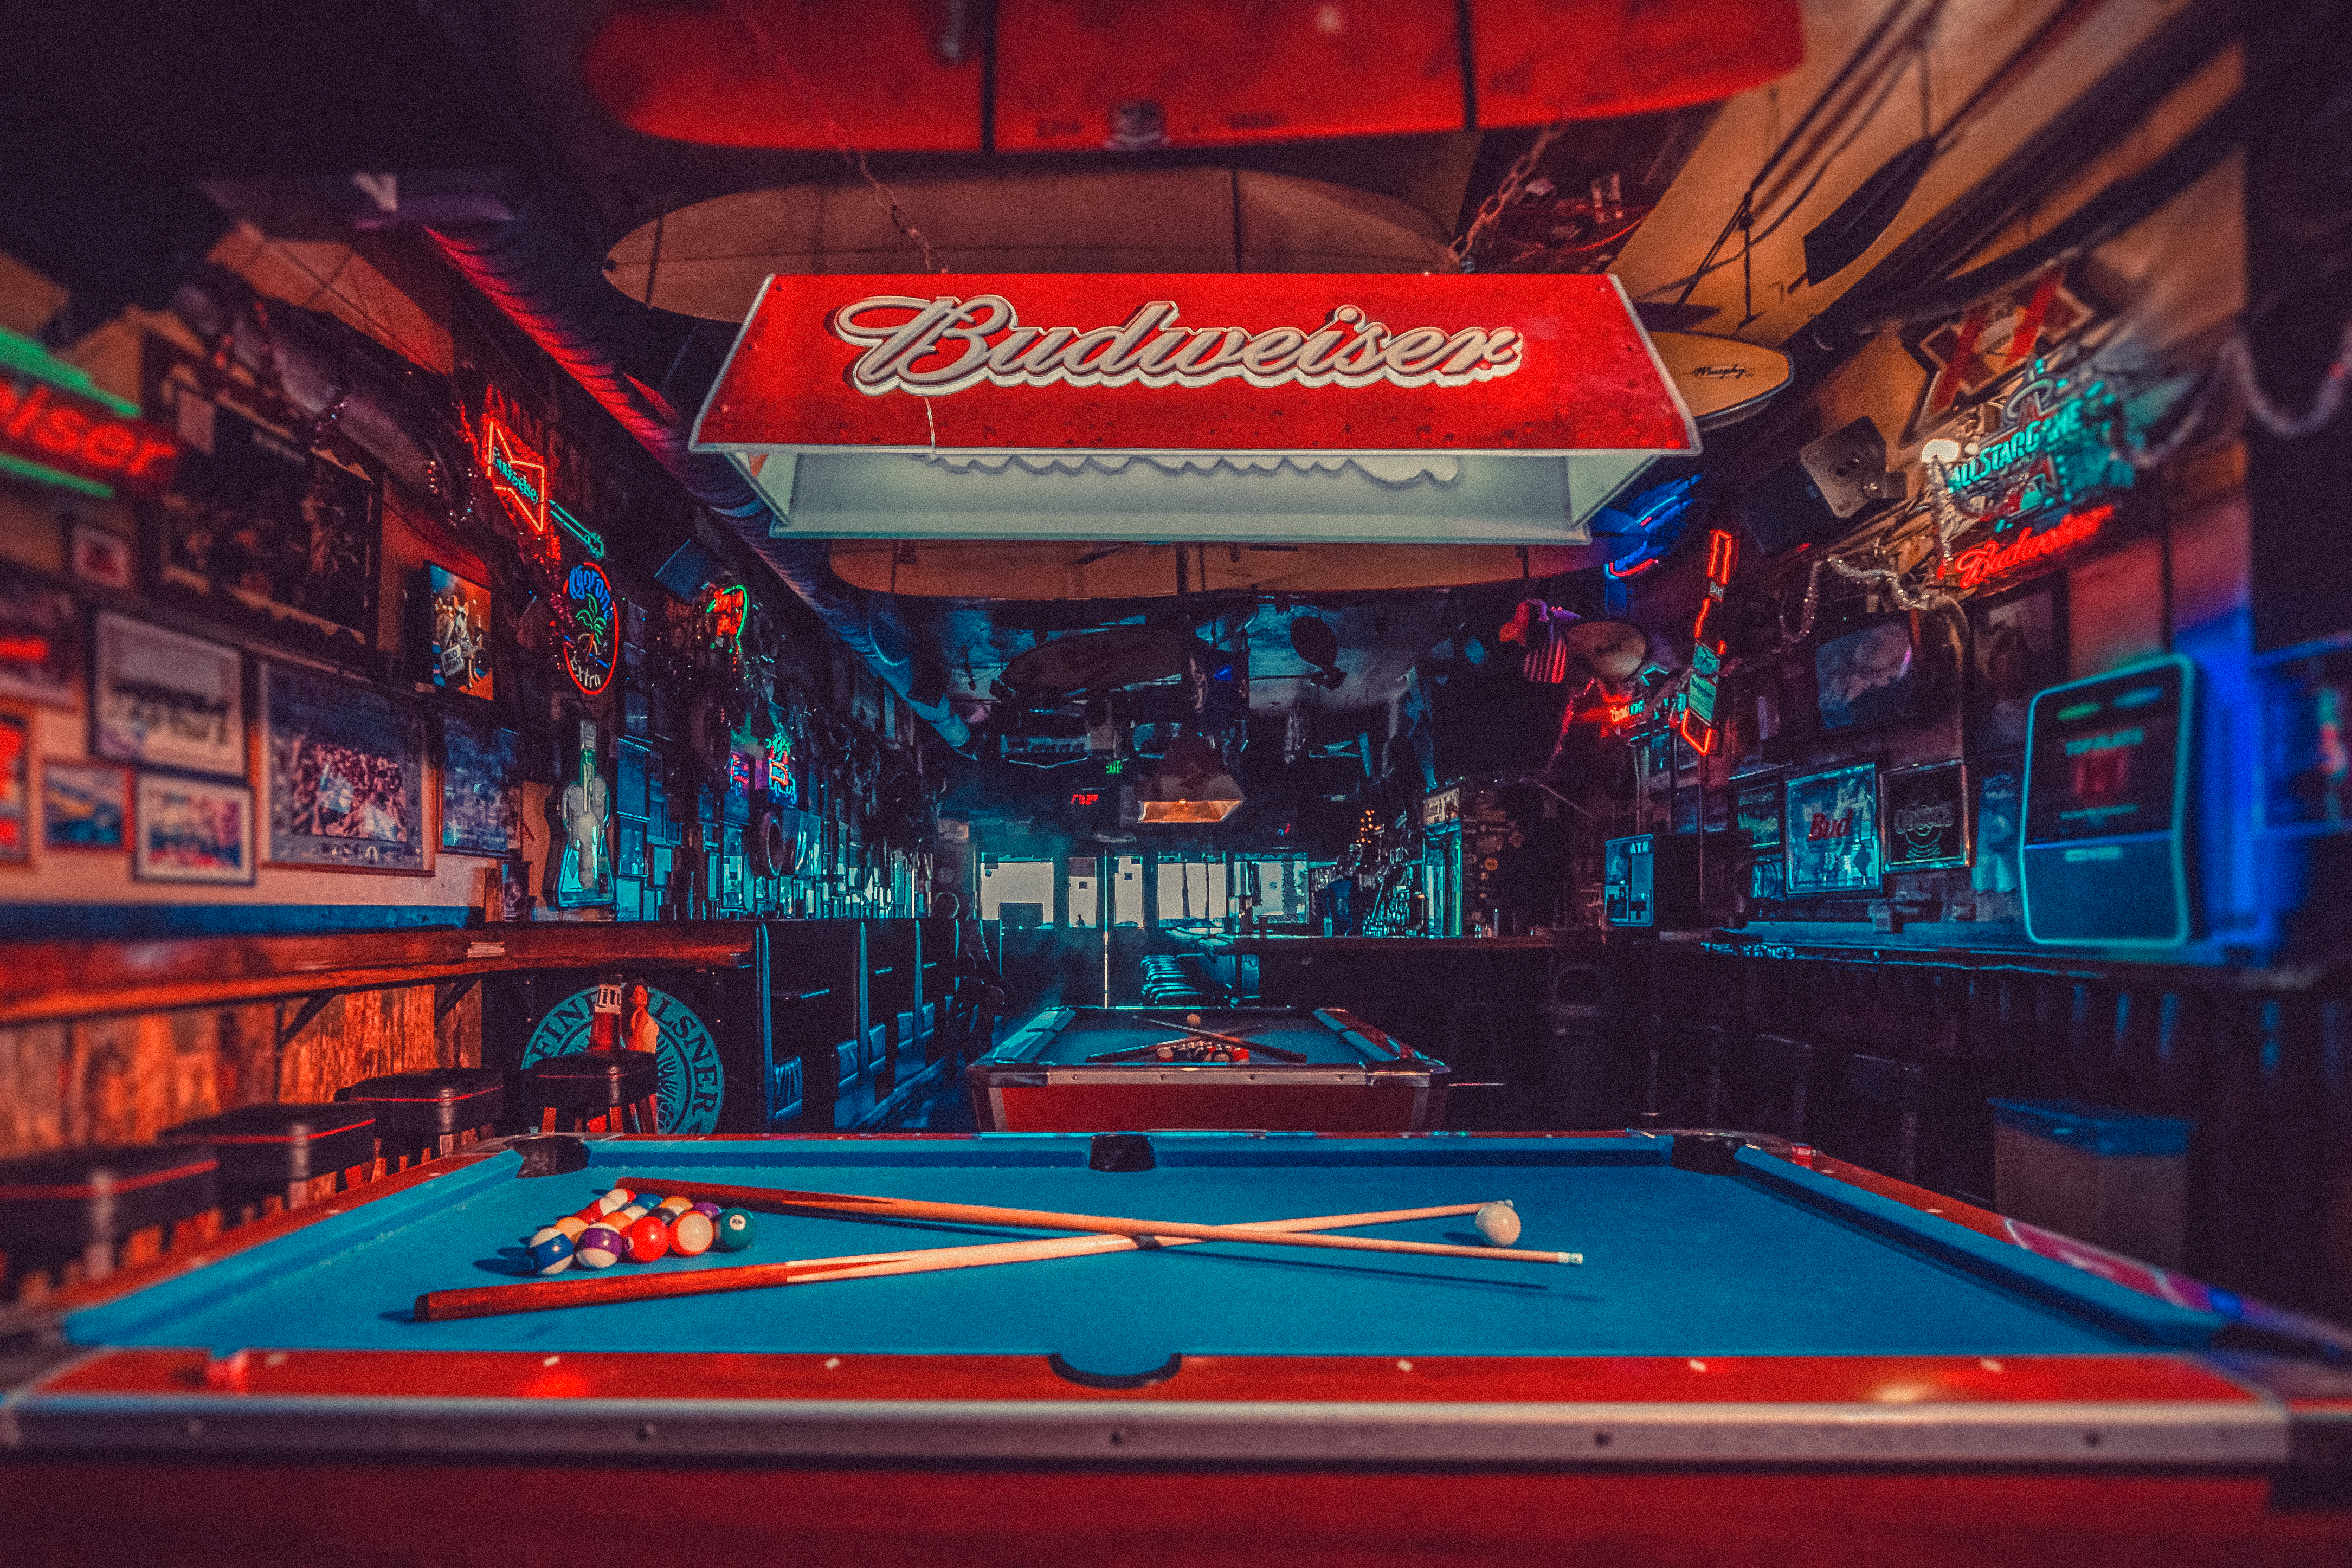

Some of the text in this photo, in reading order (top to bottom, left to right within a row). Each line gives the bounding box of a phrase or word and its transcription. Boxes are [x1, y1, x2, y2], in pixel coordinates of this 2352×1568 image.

[836, 294, 1524, 396] Budweiser
[1693, 365, 1745, 380] Murphy
[1979, 431, 2025, 478] STAR
[1807, 808, 1853, 842] Bud
